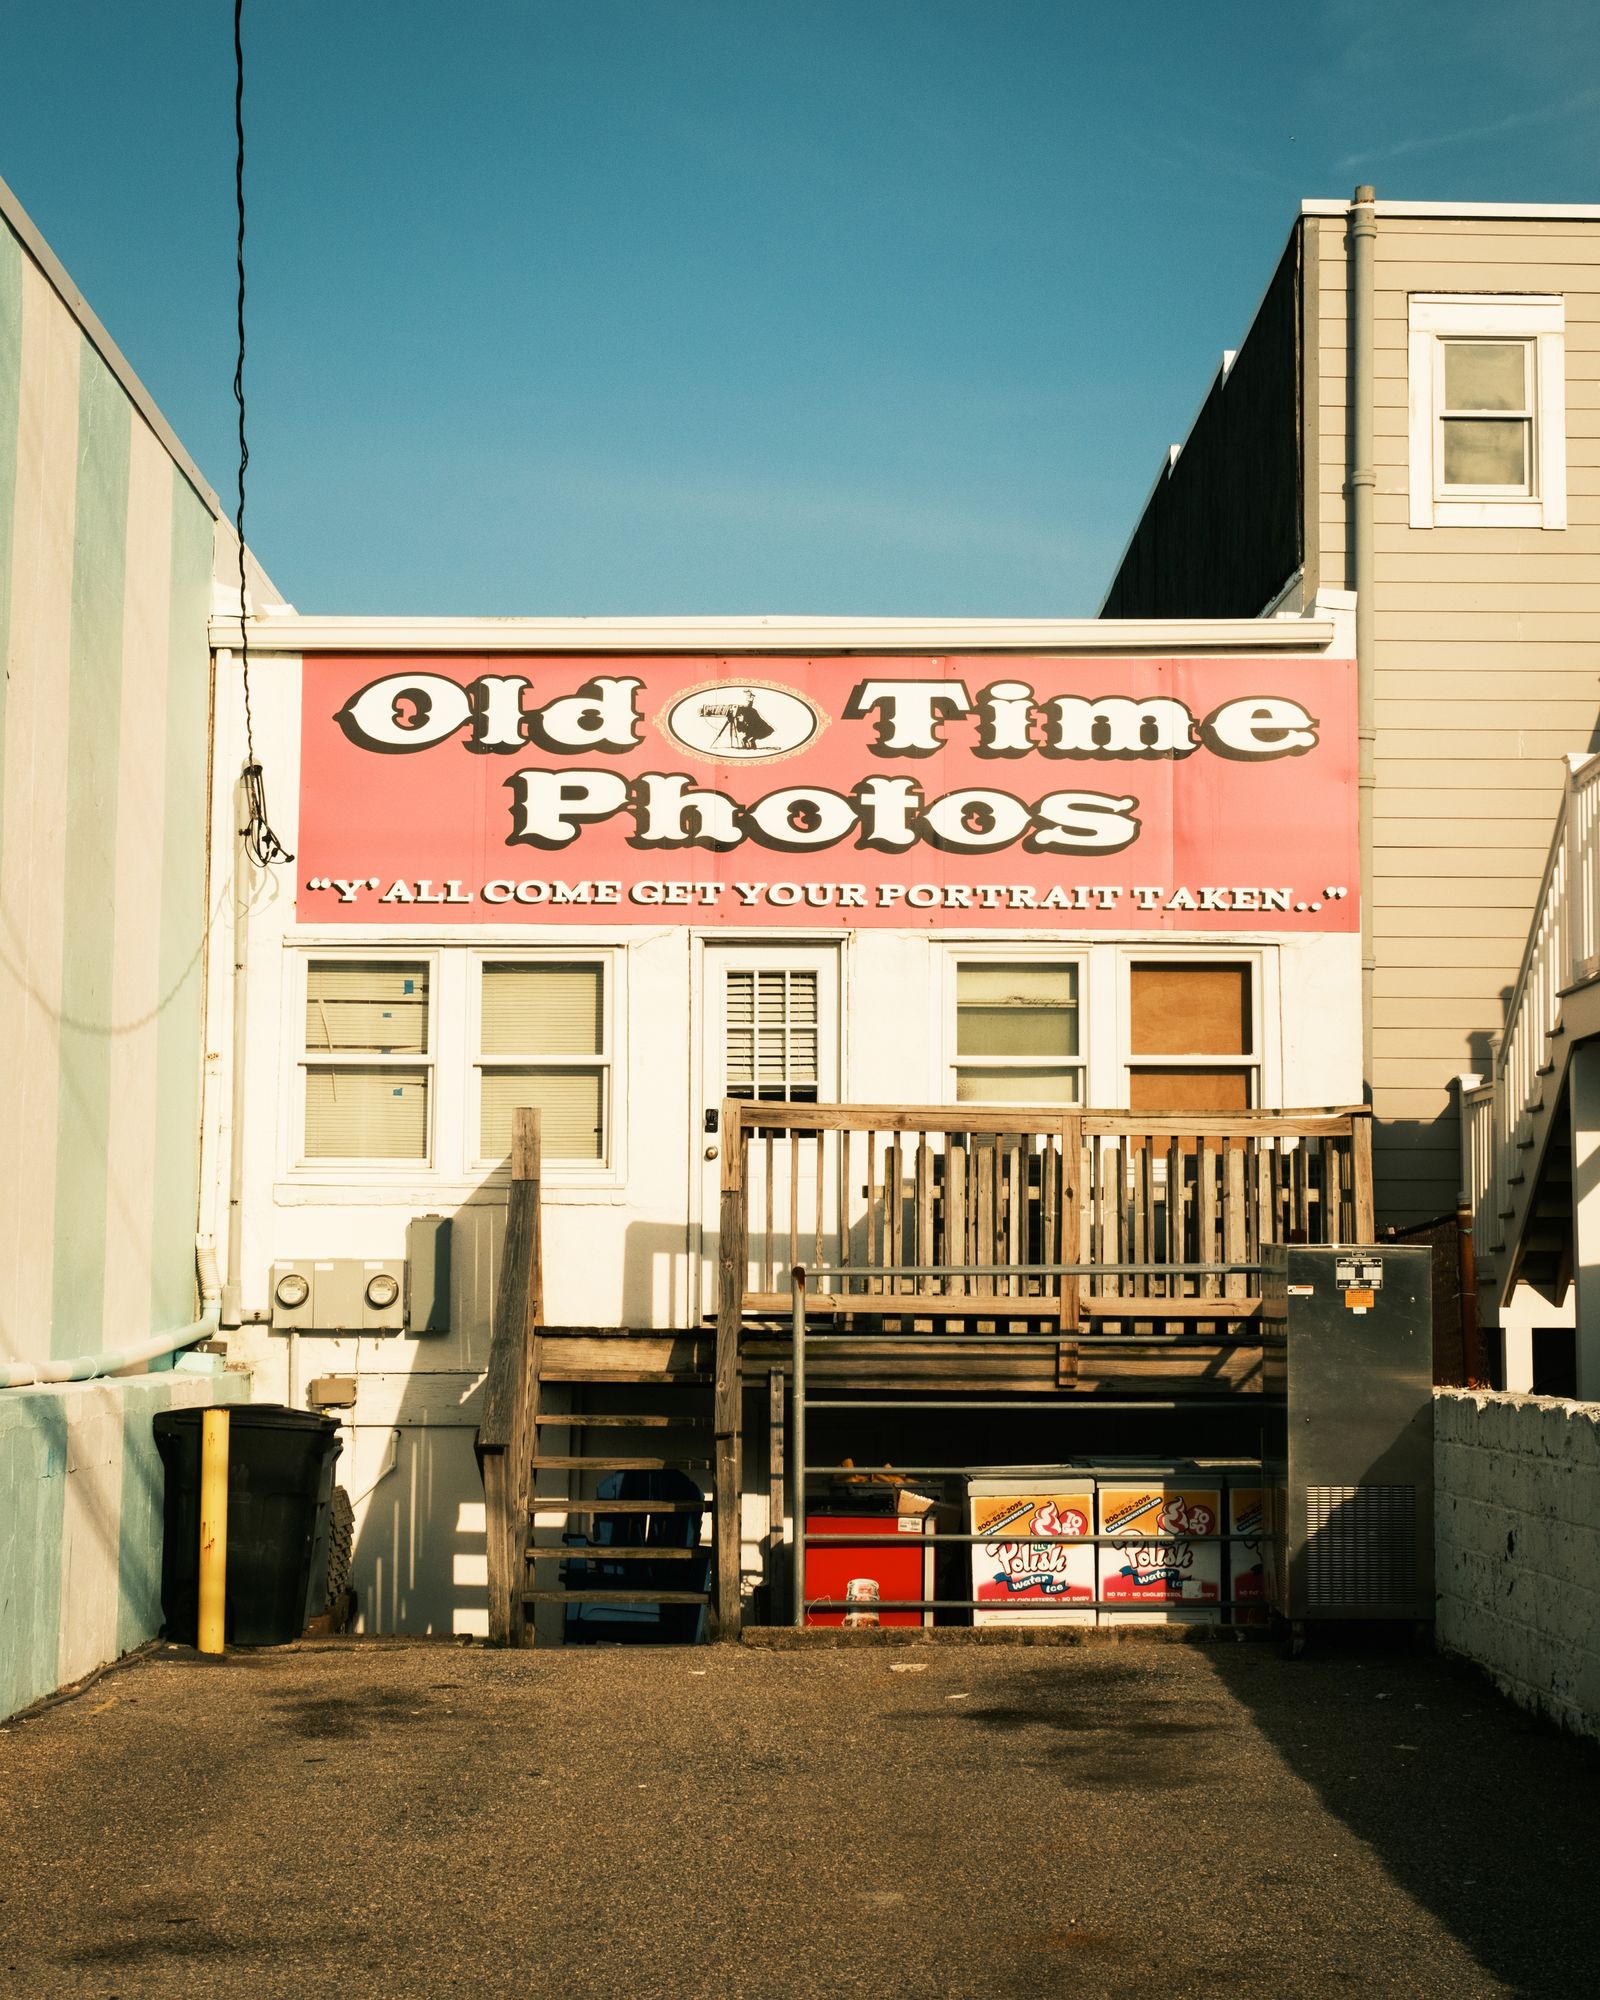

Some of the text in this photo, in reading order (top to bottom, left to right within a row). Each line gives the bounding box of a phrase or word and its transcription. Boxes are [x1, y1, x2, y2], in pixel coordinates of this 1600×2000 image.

[332, 671, 1320, 762] Old Time
[502, 767, 1142, 856] Photos
[480, 878, 622, 906] COME
[628, 880, 726, 907] GET
[733, 881, 868, 909] YOUR
[876, 883, 1124, 910] PORTRAIT
[1066, 1511, 1083, 1528] TO
[1190, 1519, 1206, 1535] GO
[1194, 1508, 1210, 1525] TO
[986, 1541, 1067, 1575] Polish
